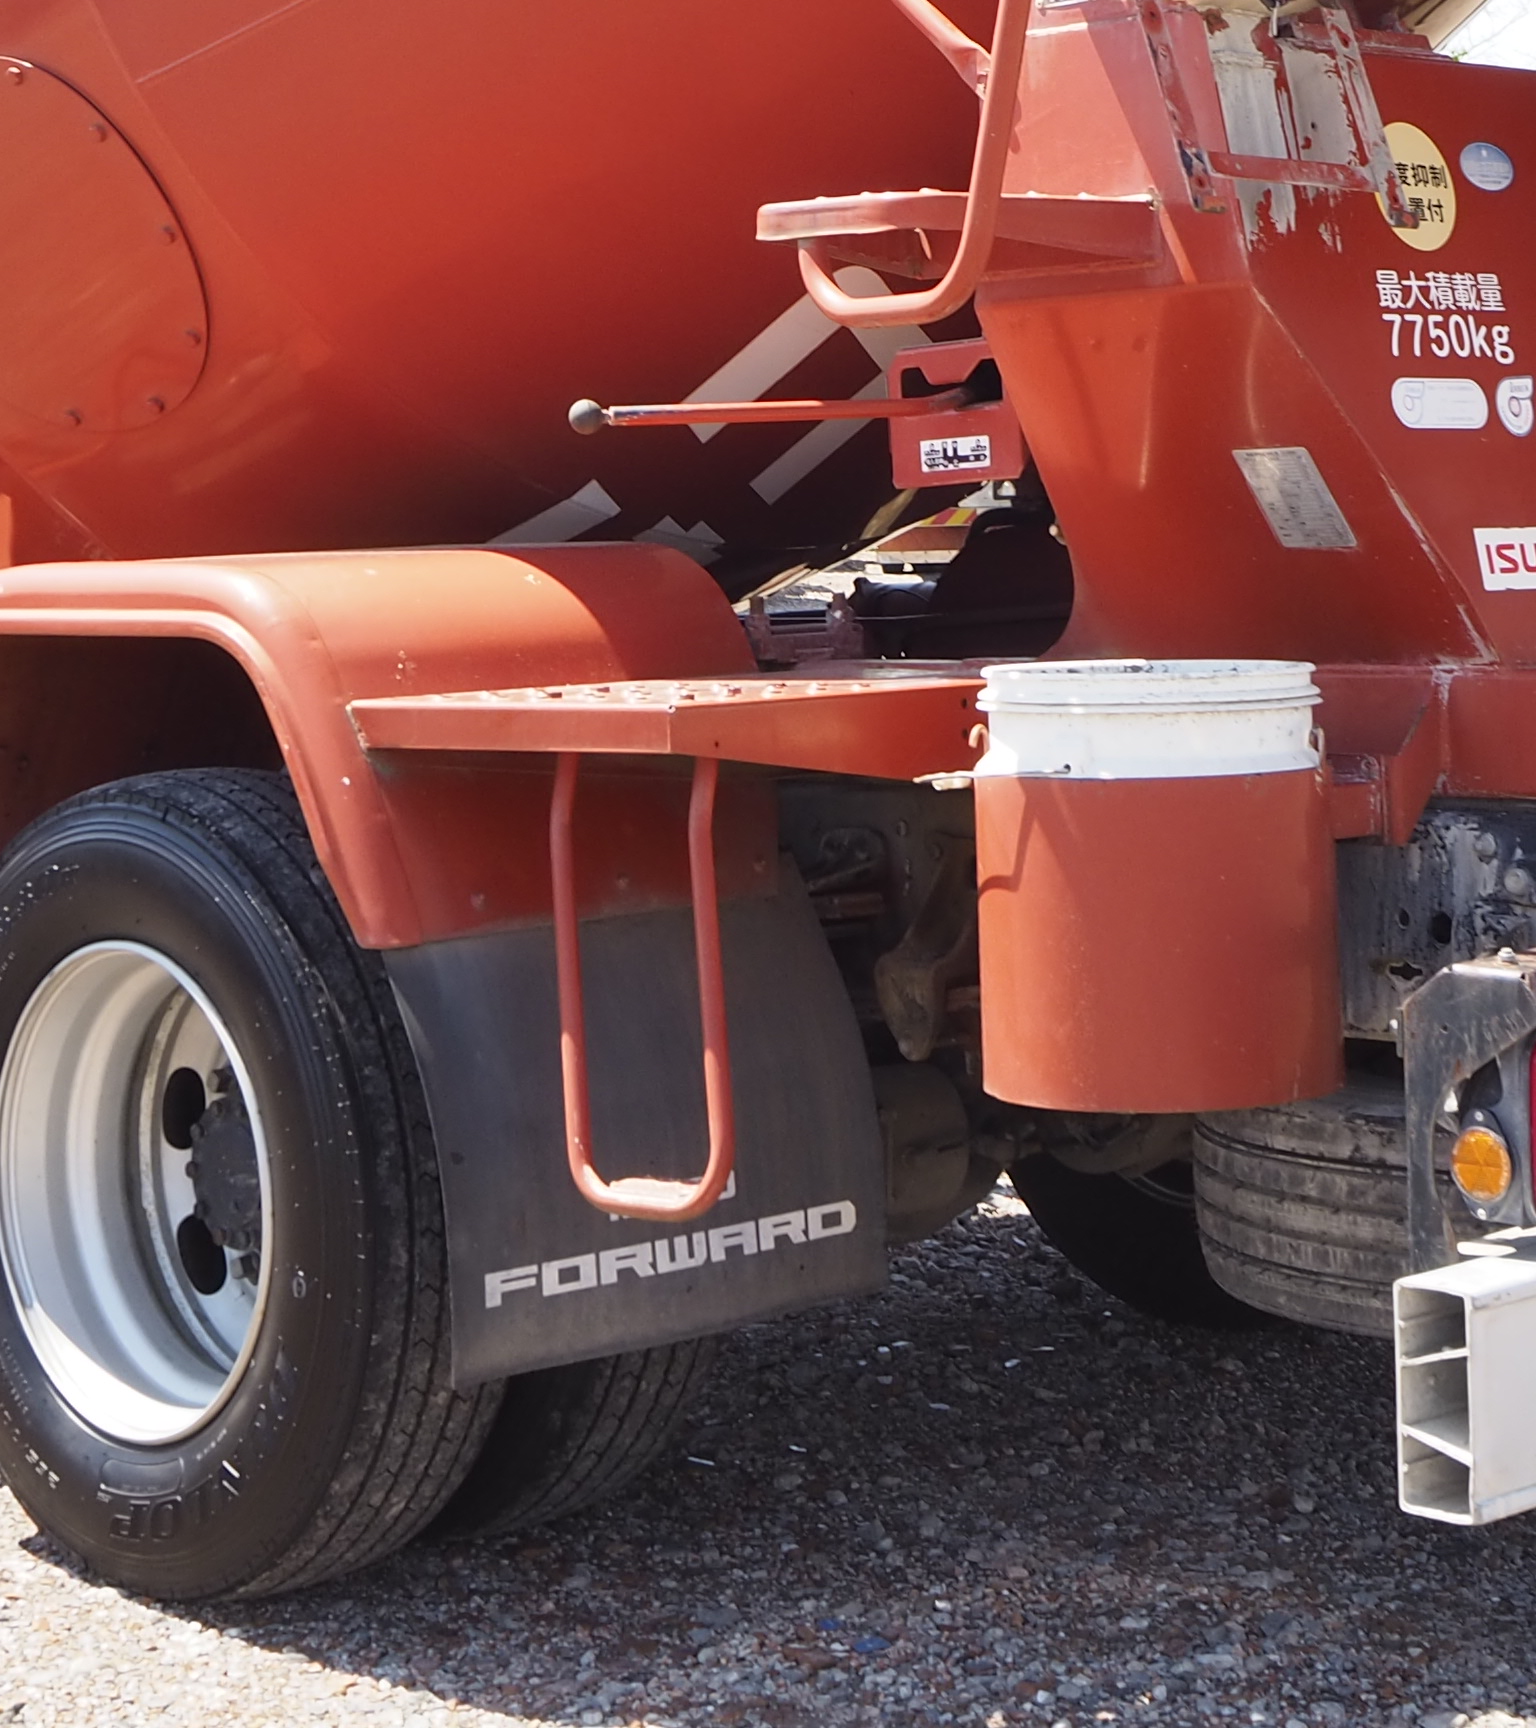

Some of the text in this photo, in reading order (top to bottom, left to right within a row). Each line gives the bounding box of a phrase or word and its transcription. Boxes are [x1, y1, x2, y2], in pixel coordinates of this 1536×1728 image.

[1375, 269, 1507, 312] 最大積載量
[1381, 313, 1515, 365] 7750kg
[484, 1199, 857, 1309] FORWARD
